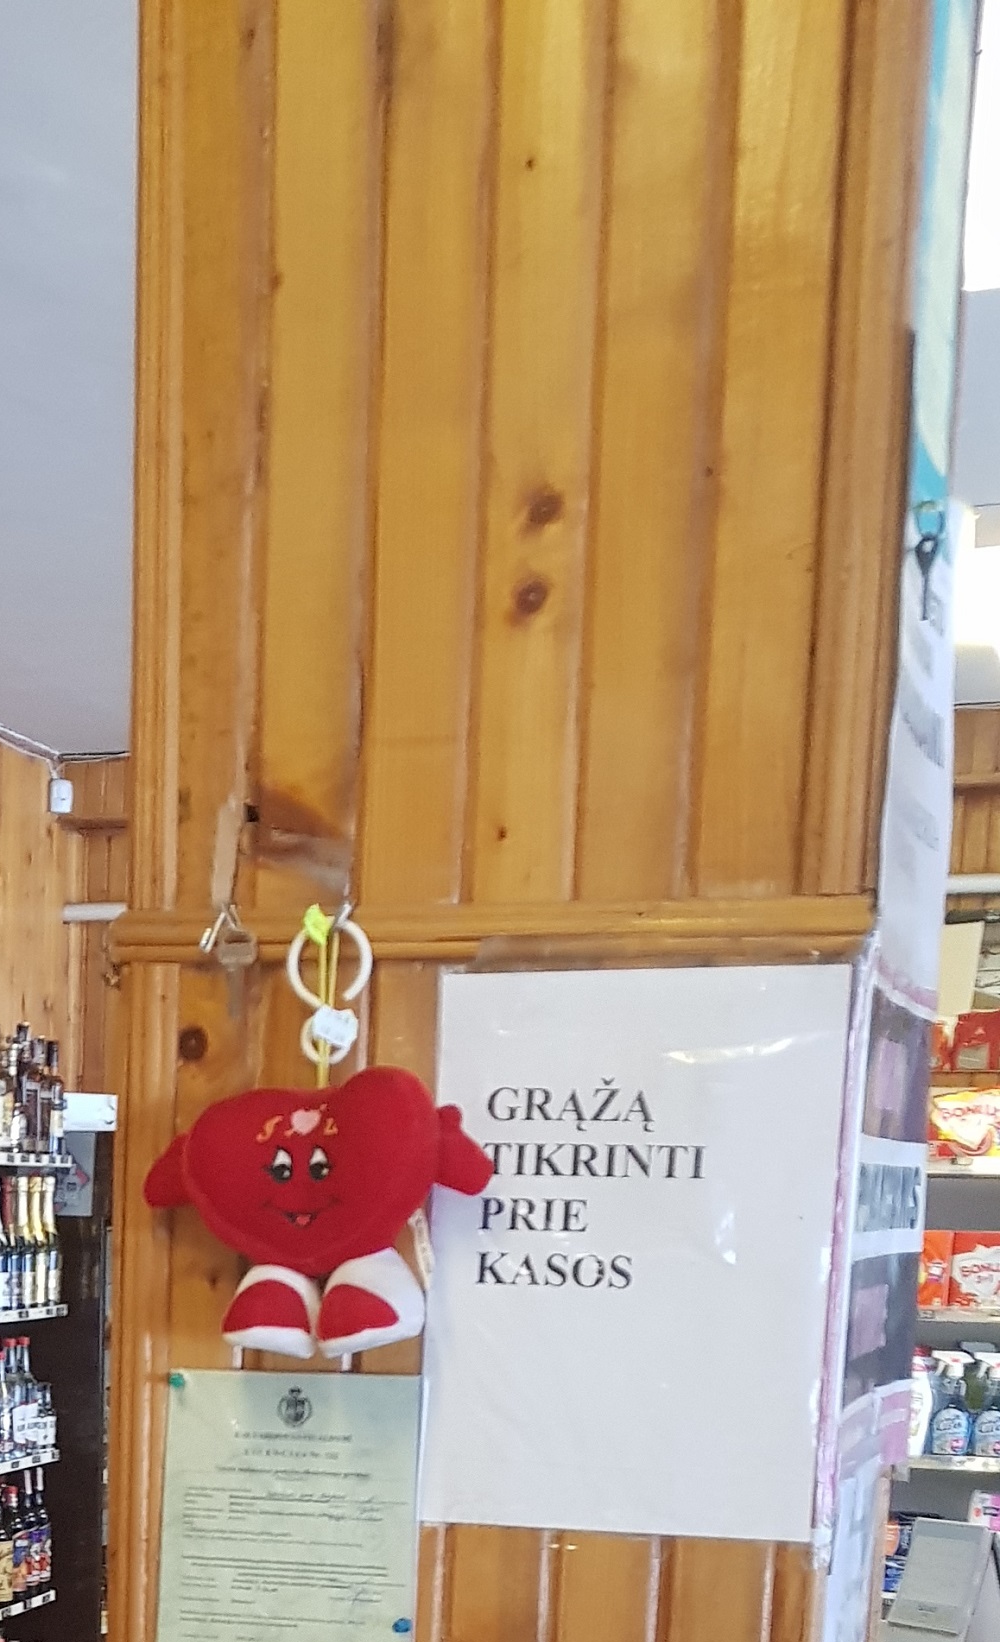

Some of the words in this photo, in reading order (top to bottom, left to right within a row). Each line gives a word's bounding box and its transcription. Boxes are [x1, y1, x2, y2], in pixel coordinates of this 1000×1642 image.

[487, 1077, 655, 1132] GRĄŽĄ
[483, 1142, 707, 1179] TIKRINTI
[478, 1197, 588, 1232] PRIE
[476, 1251, 633, 1289] KASOS
